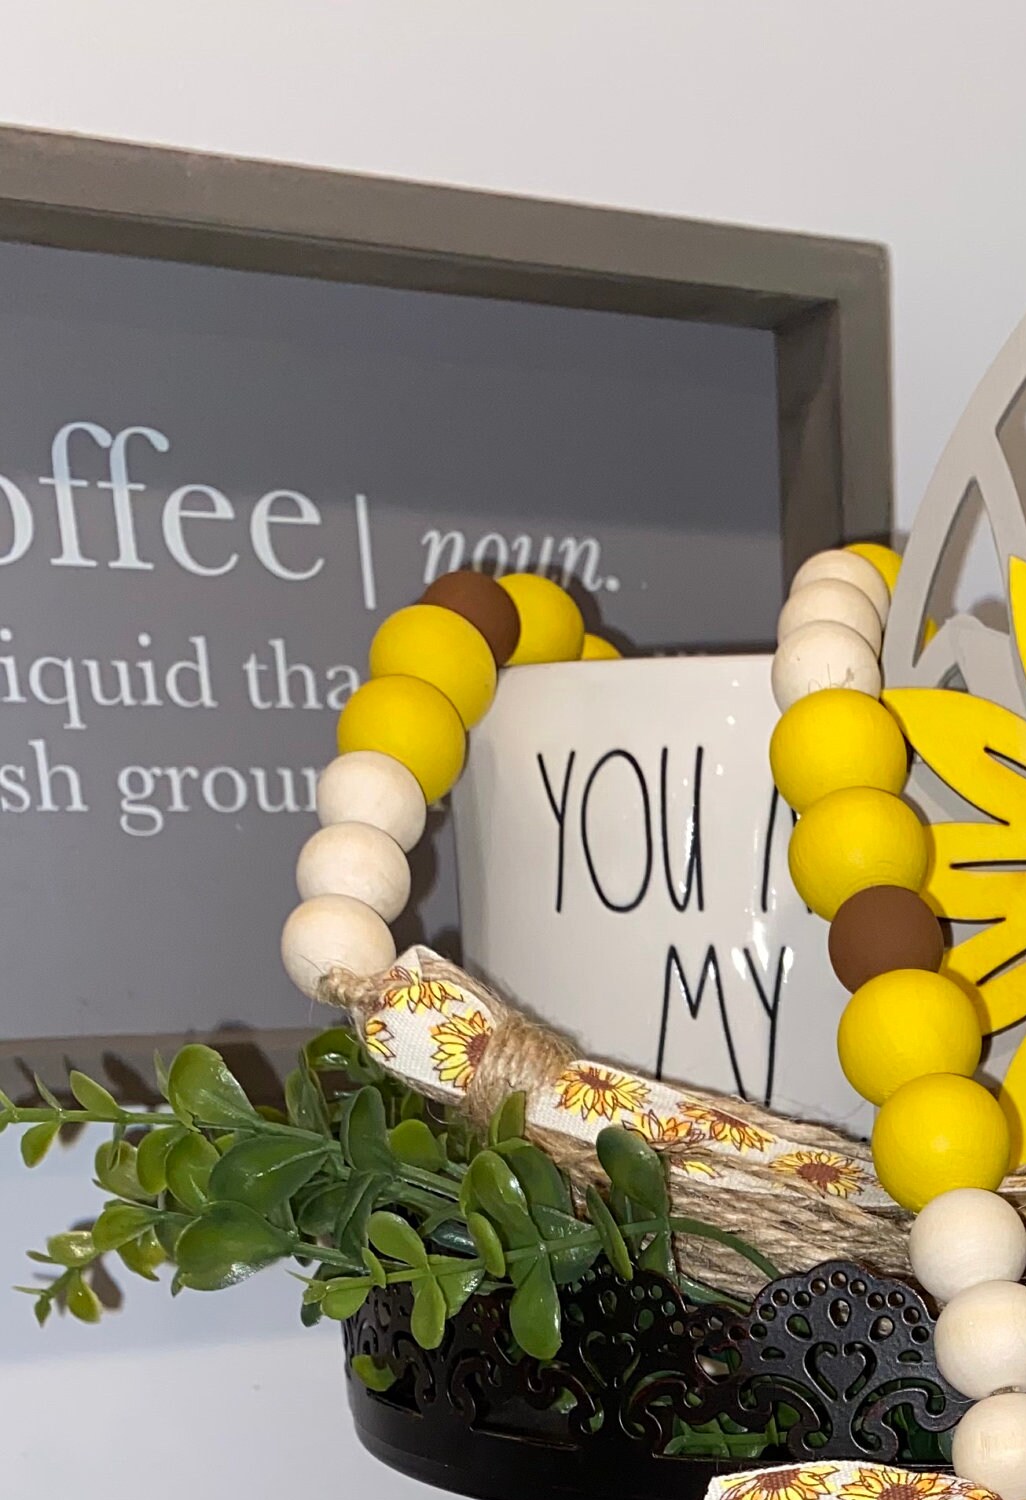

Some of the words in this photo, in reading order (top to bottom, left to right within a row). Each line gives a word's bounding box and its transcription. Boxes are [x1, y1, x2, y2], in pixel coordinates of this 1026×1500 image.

[0, 628, 219, 730] iquid
[537, 745, 705, 914] YOU
[655, 944, 788, 1107] MY
